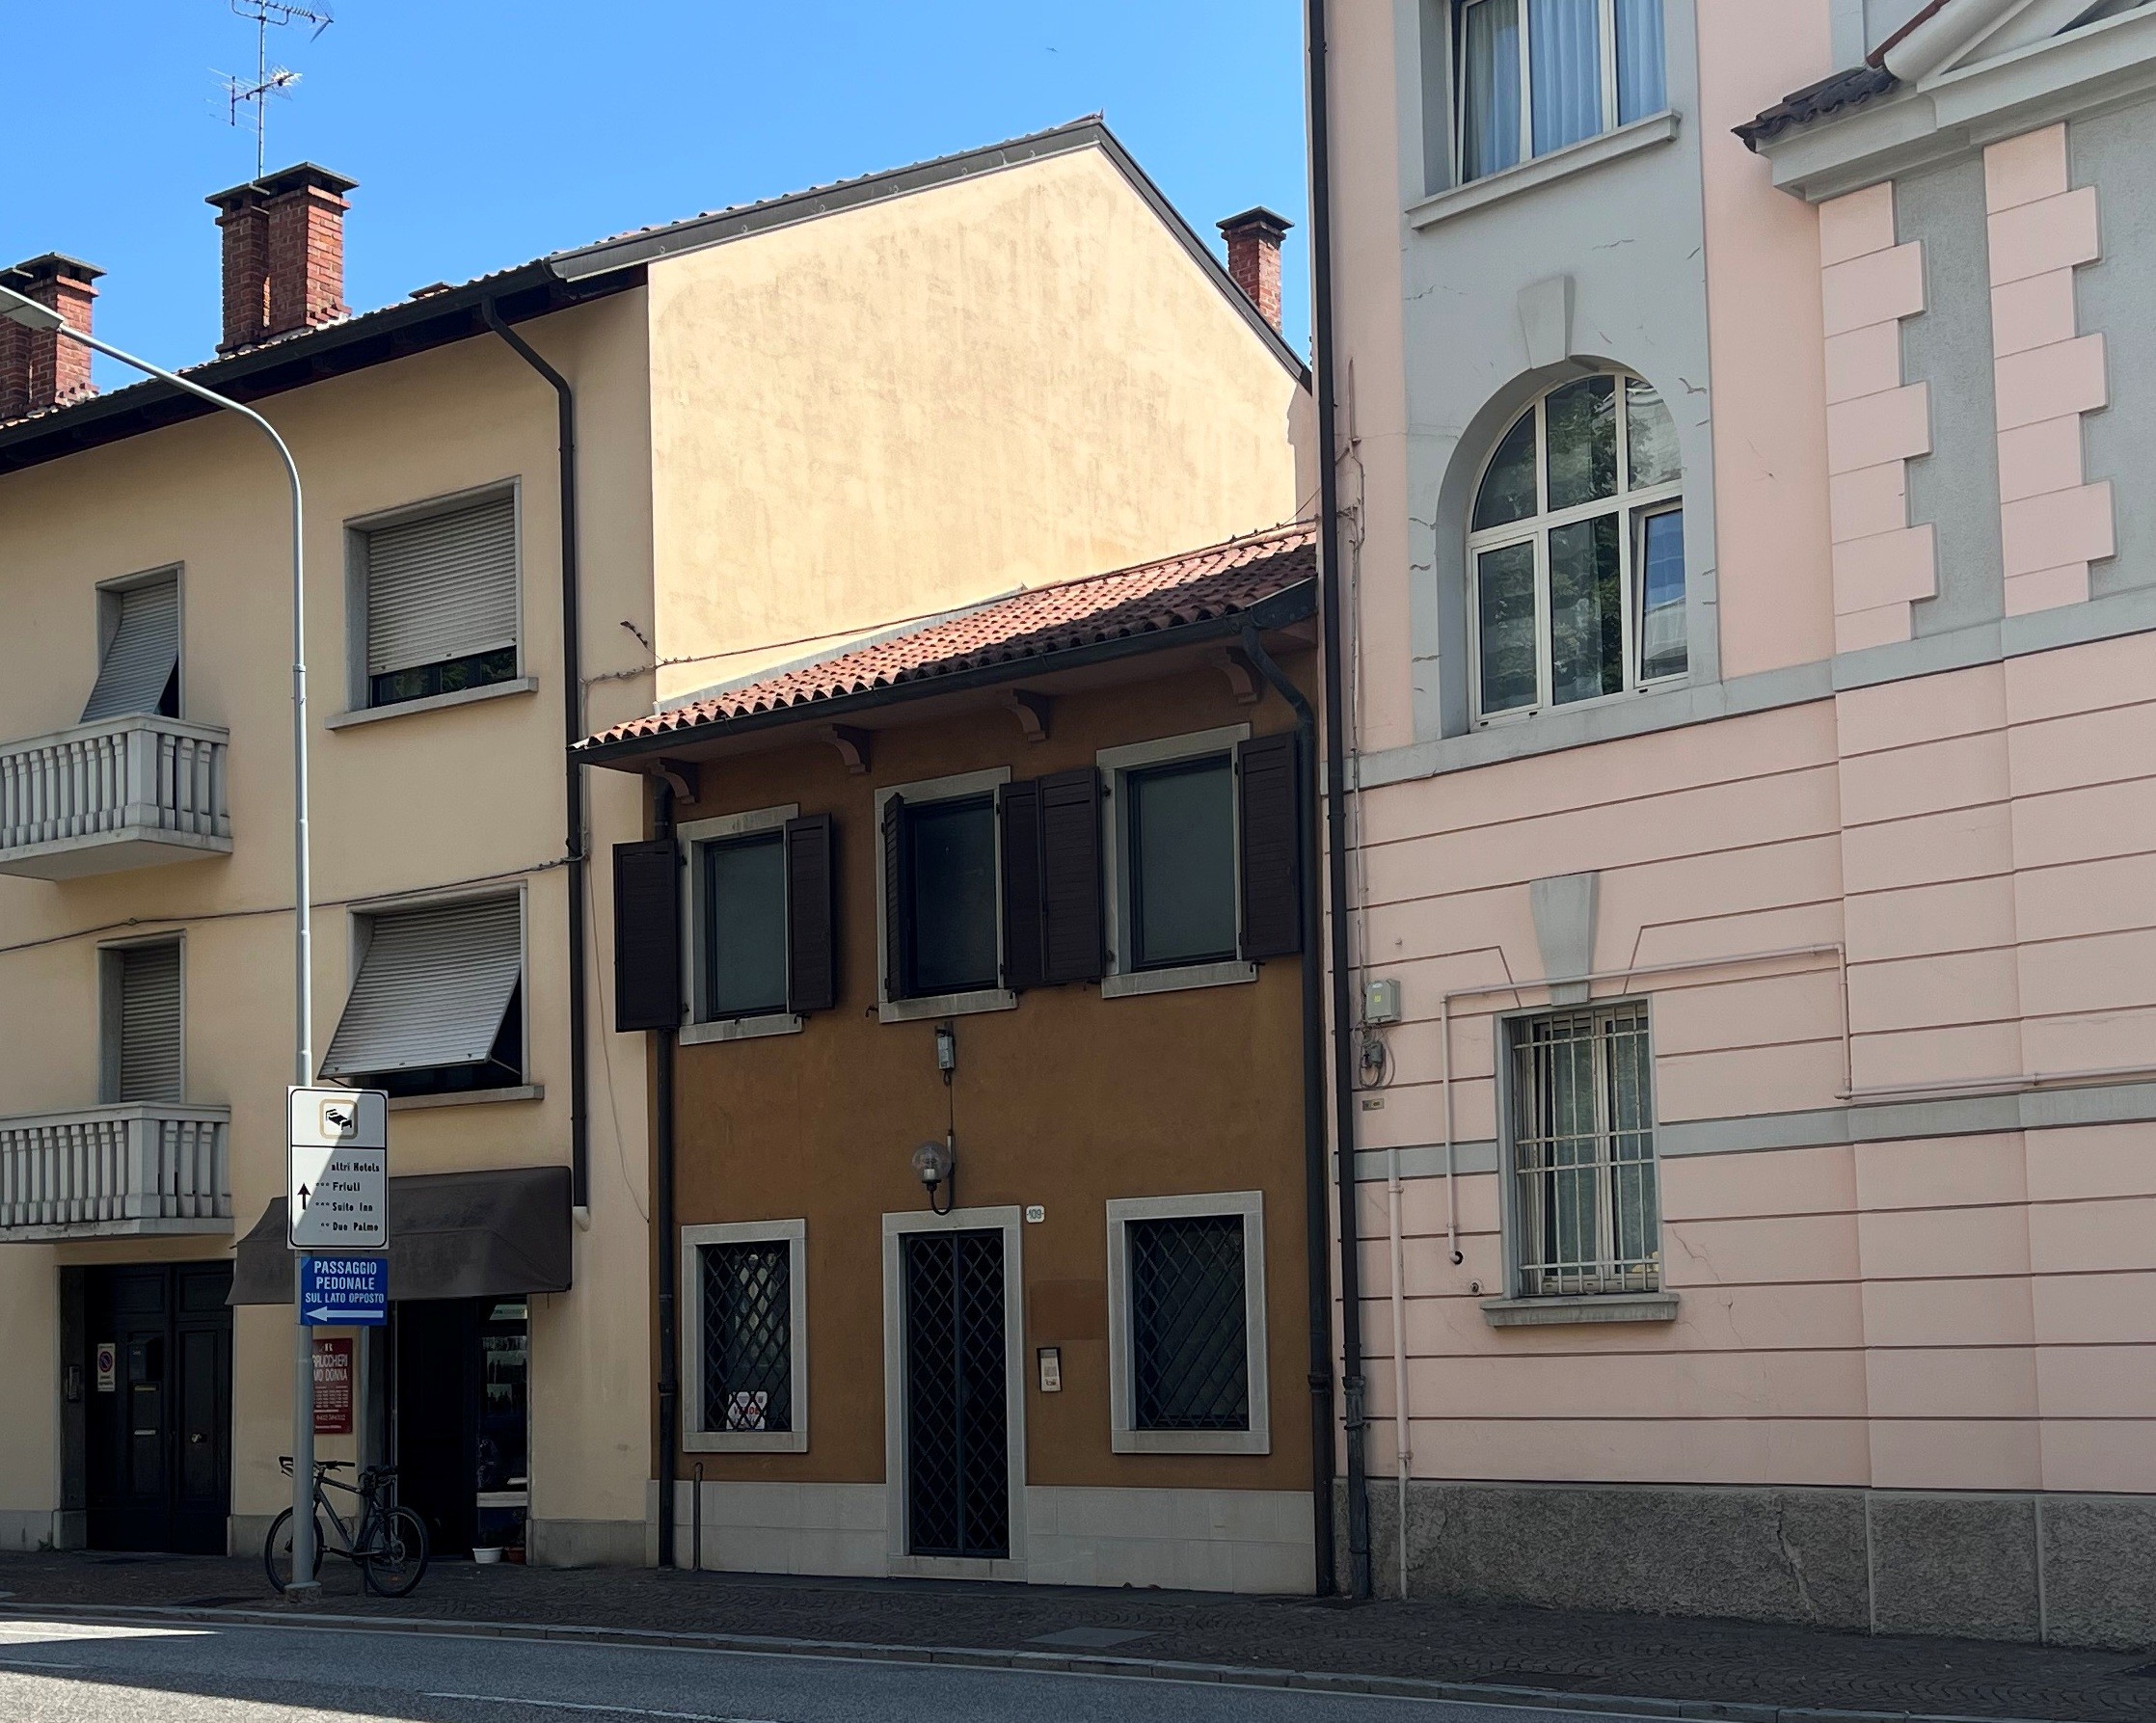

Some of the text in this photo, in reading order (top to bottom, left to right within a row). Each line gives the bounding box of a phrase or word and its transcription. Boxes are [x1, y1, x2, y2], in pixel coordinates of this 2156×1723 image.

[331, 1162, 380, 1172] altri Hotels
[333, 1181, 361, 1192] Friuli
[332, 1202, 373, 1212] Suite Inn
[1028, 1208, 1042, 1220] 109
[333, 1222, 379, 1231] Due Palme
[313, 1260, 377, 1275] PASSAGGIO
[315, 1277, 375, 1290] PEDONALE
[305, 1292, 385, 1304] SUL LATO OPPOSTO
